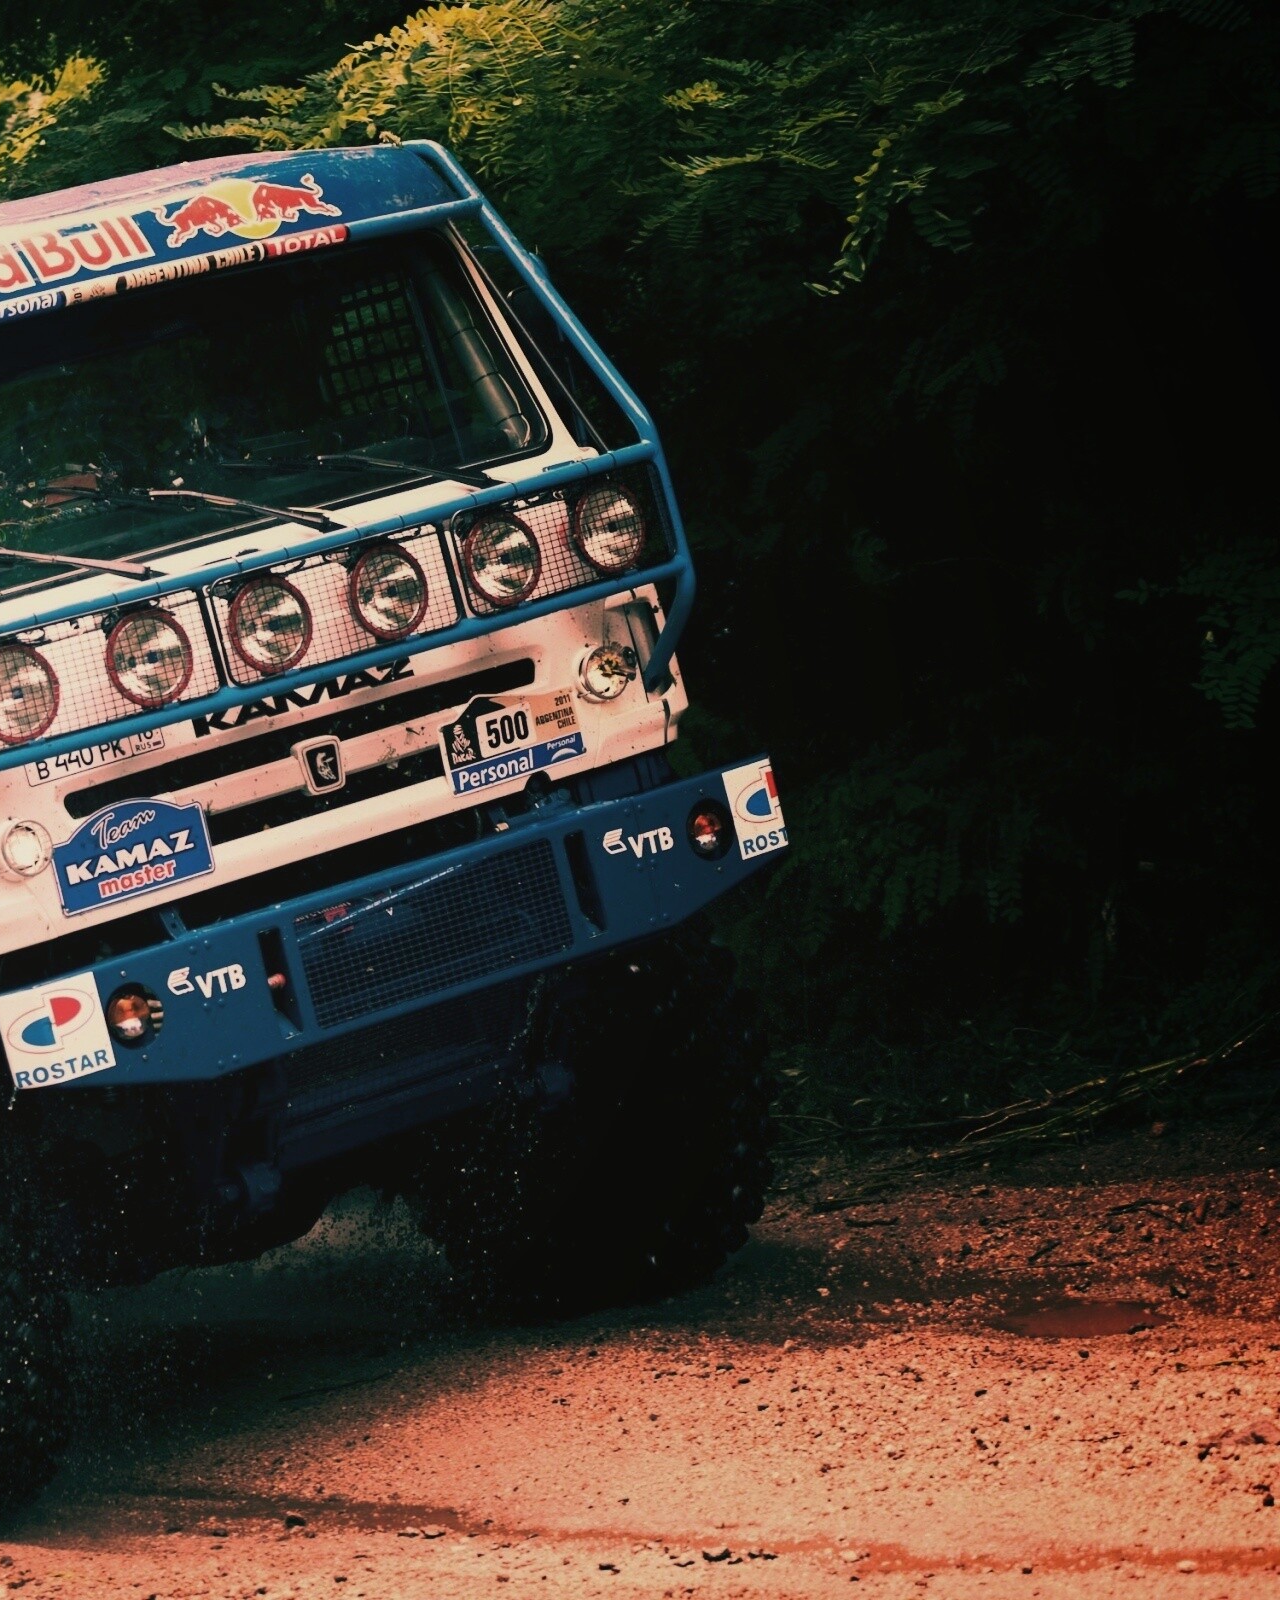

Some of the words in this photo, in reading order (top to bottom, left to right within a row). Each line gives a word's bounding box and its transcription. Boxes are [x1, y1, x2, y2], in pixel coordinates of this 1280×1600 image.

[21, 217, 149, 279] Bull
[270, 230, 344, 256] TOTAL
[126, 256, 210, 291] ARGENTINA
[216, 246, 256, 269] CHILE
[192, 657, 415, 737] KAMAZ
[535, 706, 573, 726] ARGENTINA
[486, 710, 529, 748] 500
[547, 735, 576, 750] Personal
[558, 718, 576, 729] CHILE
[135, 742, 151, 751] RUS
[458, 749, 534, 790] Personal
[91, 810, 156, 849] Team
[627, 826, 674, 859] VTB
[743, 826, 789, 855] ROST
[65, 829, 195, 885] KAMAZ
[98, 859, 176, 898] master
[195, 963, 246, 998] VTB
[15, 1049, 109, 1088] ROSTAR
